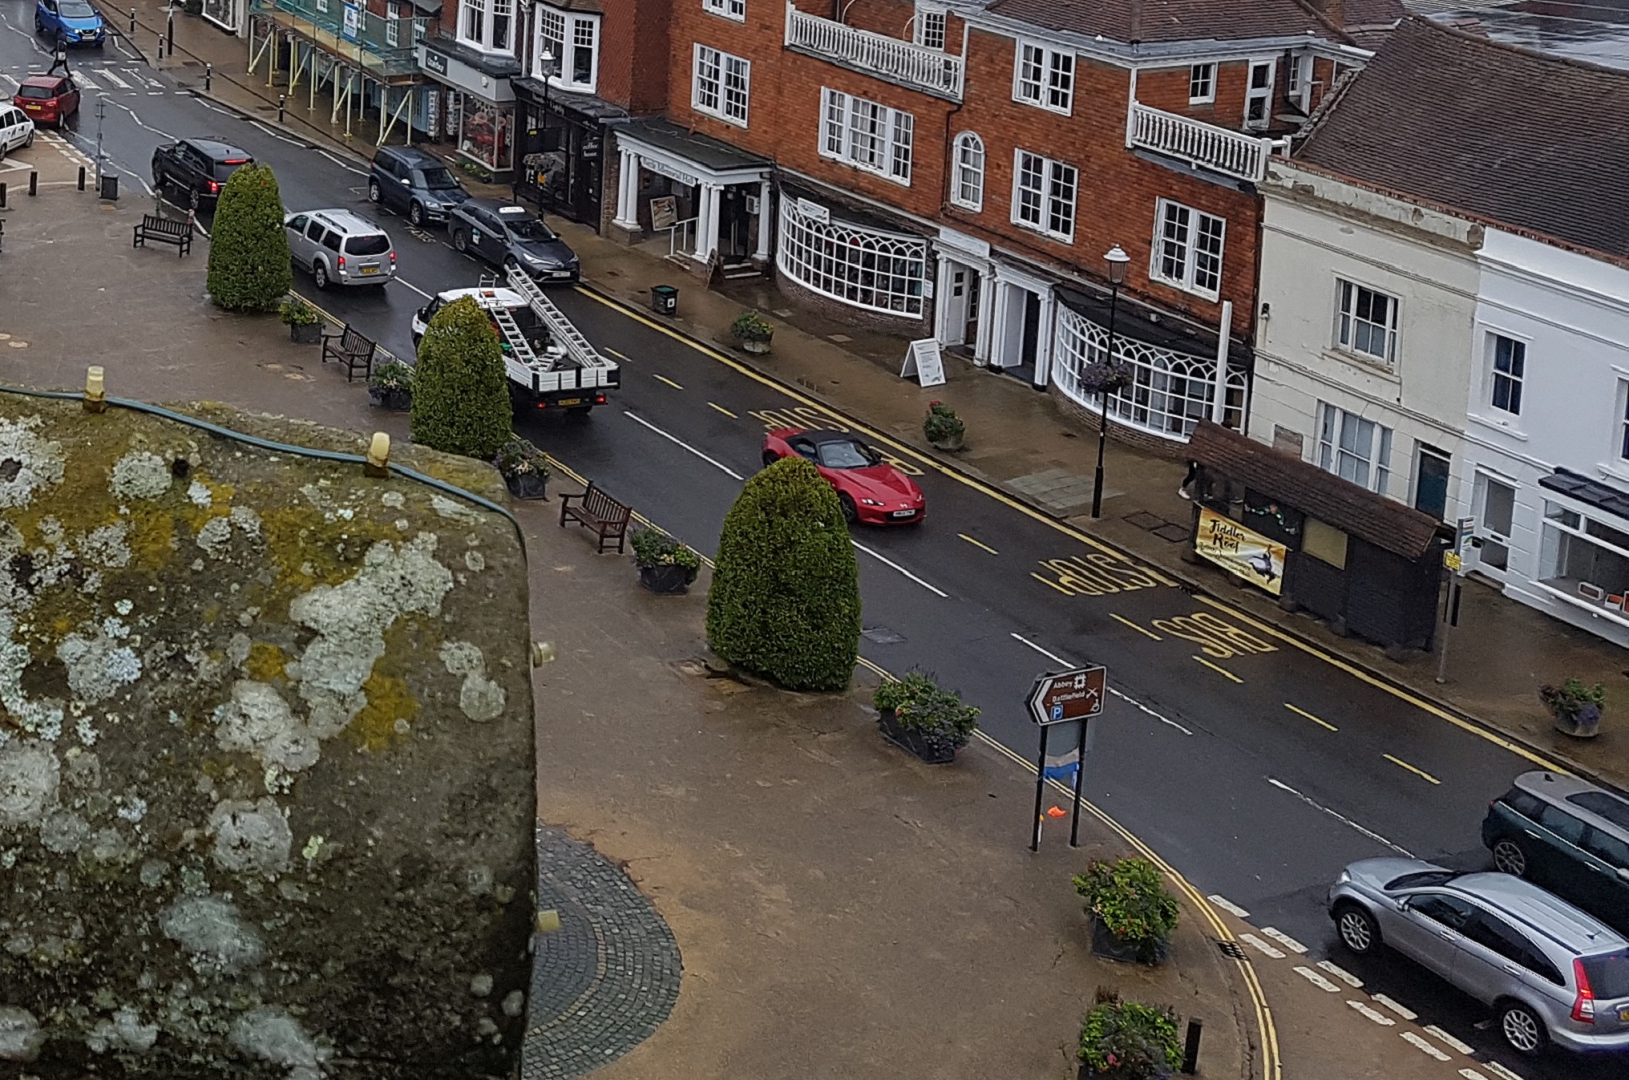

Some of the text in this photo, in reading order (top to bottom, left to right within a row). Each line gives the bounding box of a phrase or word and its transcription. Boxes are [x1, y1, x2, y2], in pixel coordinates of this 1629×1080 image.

[1038, 553, 1157, 596] STOP
[1151, 612, 1280, 659] BUS
[1053, 681, 1073, 689] Abbey
[1052, 690, 1085, 703] Battlefield
[1053, 707, 1061, 719] P
